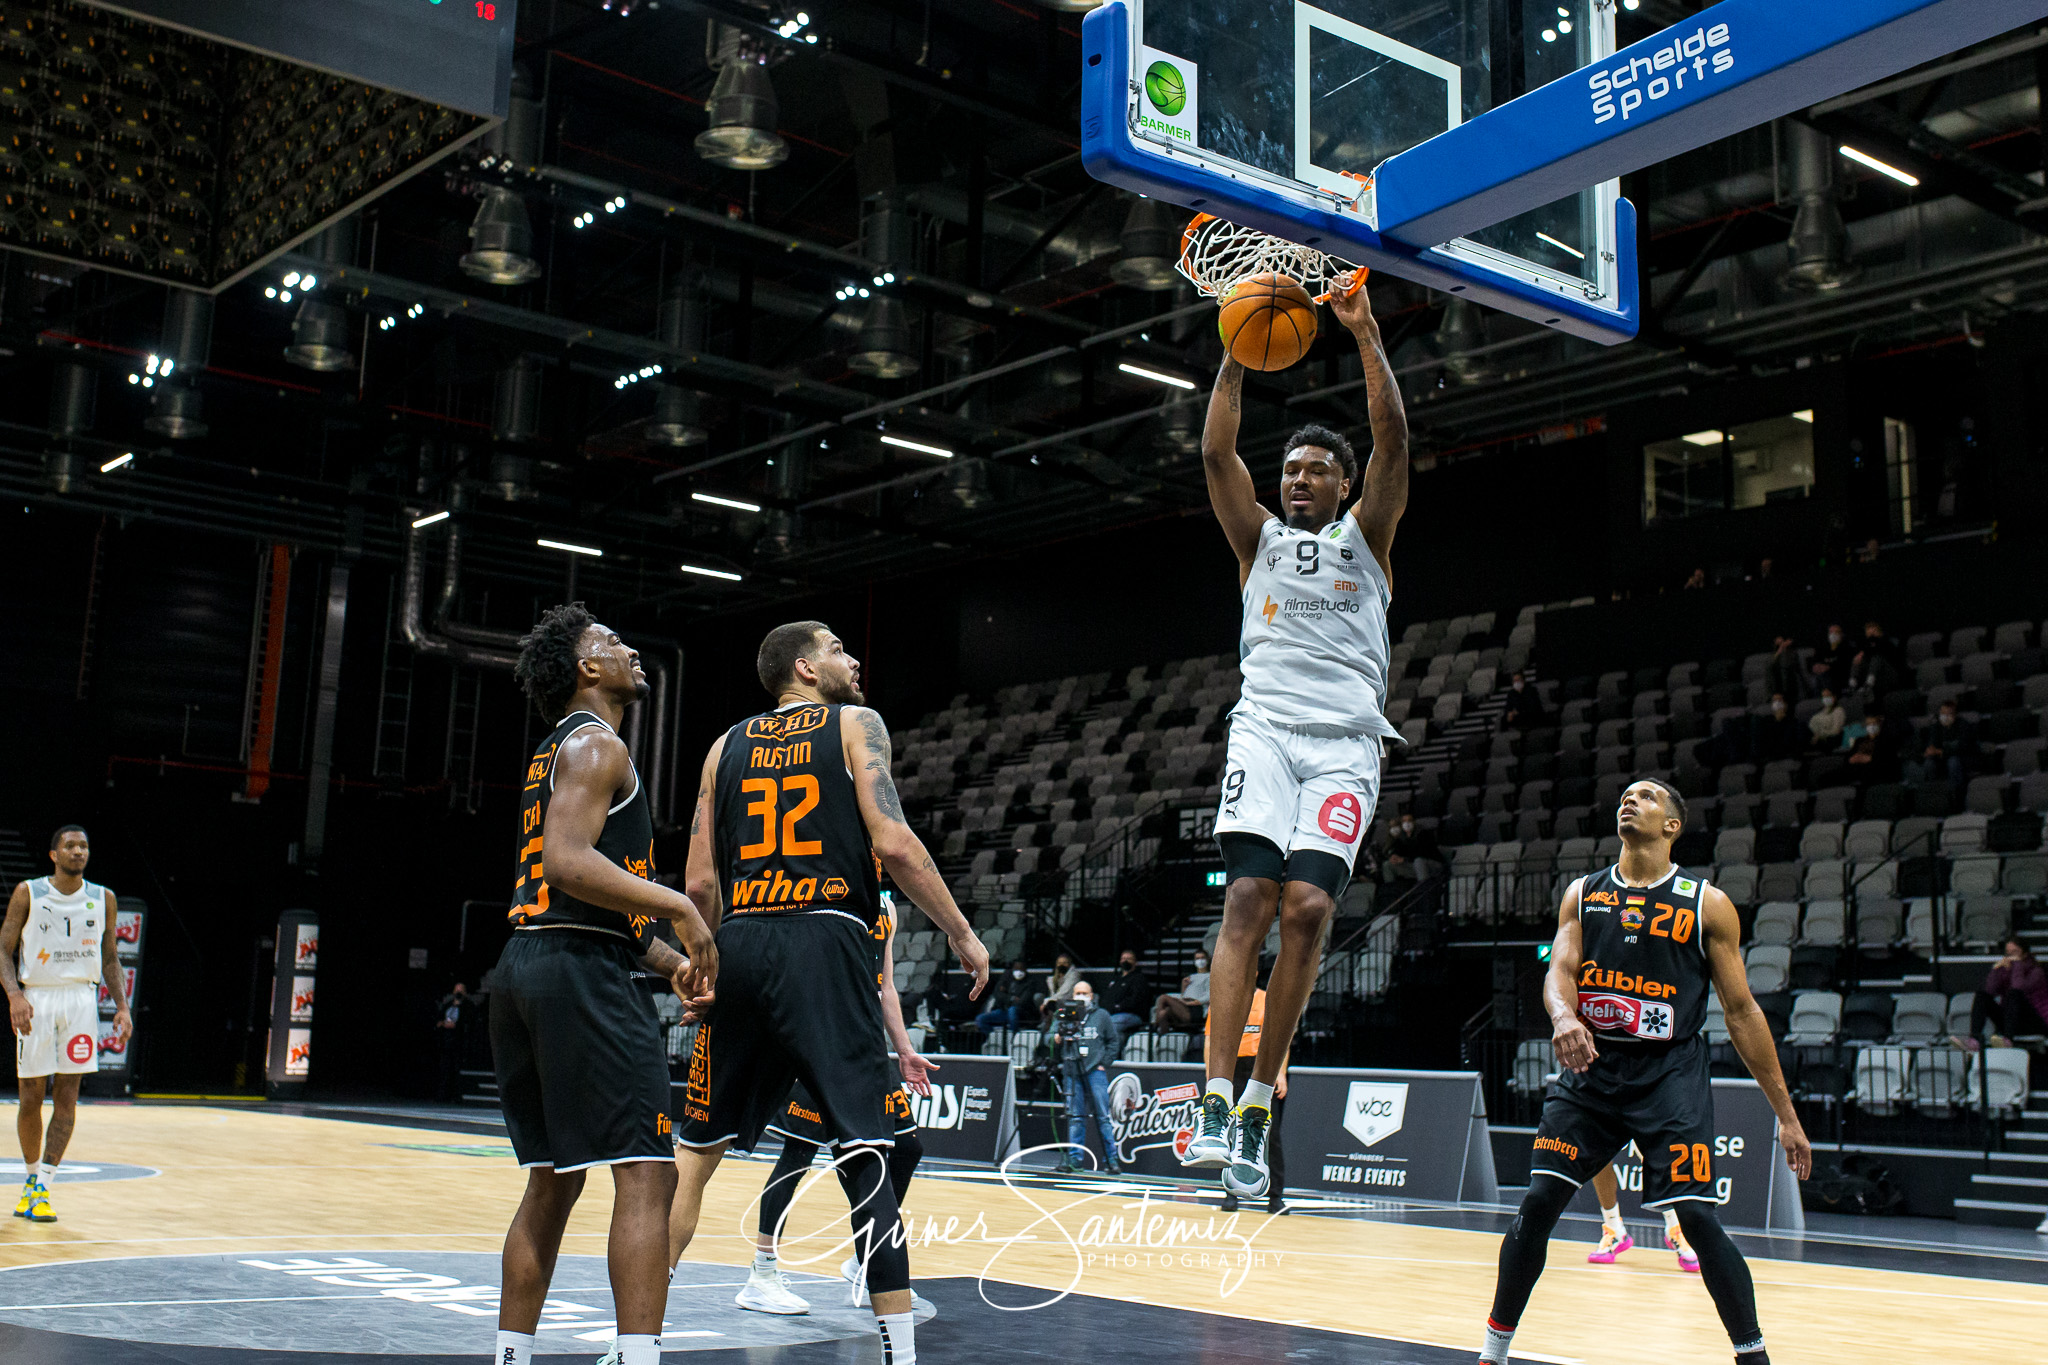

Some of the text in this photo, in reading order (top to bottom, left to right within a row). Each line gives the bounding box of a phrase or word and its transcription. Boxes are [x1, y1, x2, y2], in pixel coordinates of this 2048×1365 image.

[475, 1, 495, 20] 18
[1588, 23, 1730, 99] Schelde
[1140, 115, 1191, 141] BARMER
[1296, 540, 1320, 575] 9
[1334, 580, 1358, 592] EMS
[1284, 598, 1360, 614] filmstudio
[1284, 612, 1323, 620] nürnberg
[750, 741, 812, 769] AUSTIN
[1224, 769, 1246, 804] 9
[740, 774, 823, 860] 32
[1649, 902, 1695, 944] 20
[1624, 935, 1638, 944] #10
[1578, 960, 1677, 999] Kübler
[1581, 1002, 1636, 1023] Helios
[684, 1103, 709, 1123] ÜCHEN
[1114, 1096, 1199, 1141] Falcons
[1669, 1143, 1711, 1183] 20
[1363, 1168, 1407, 1187] EVENTS
